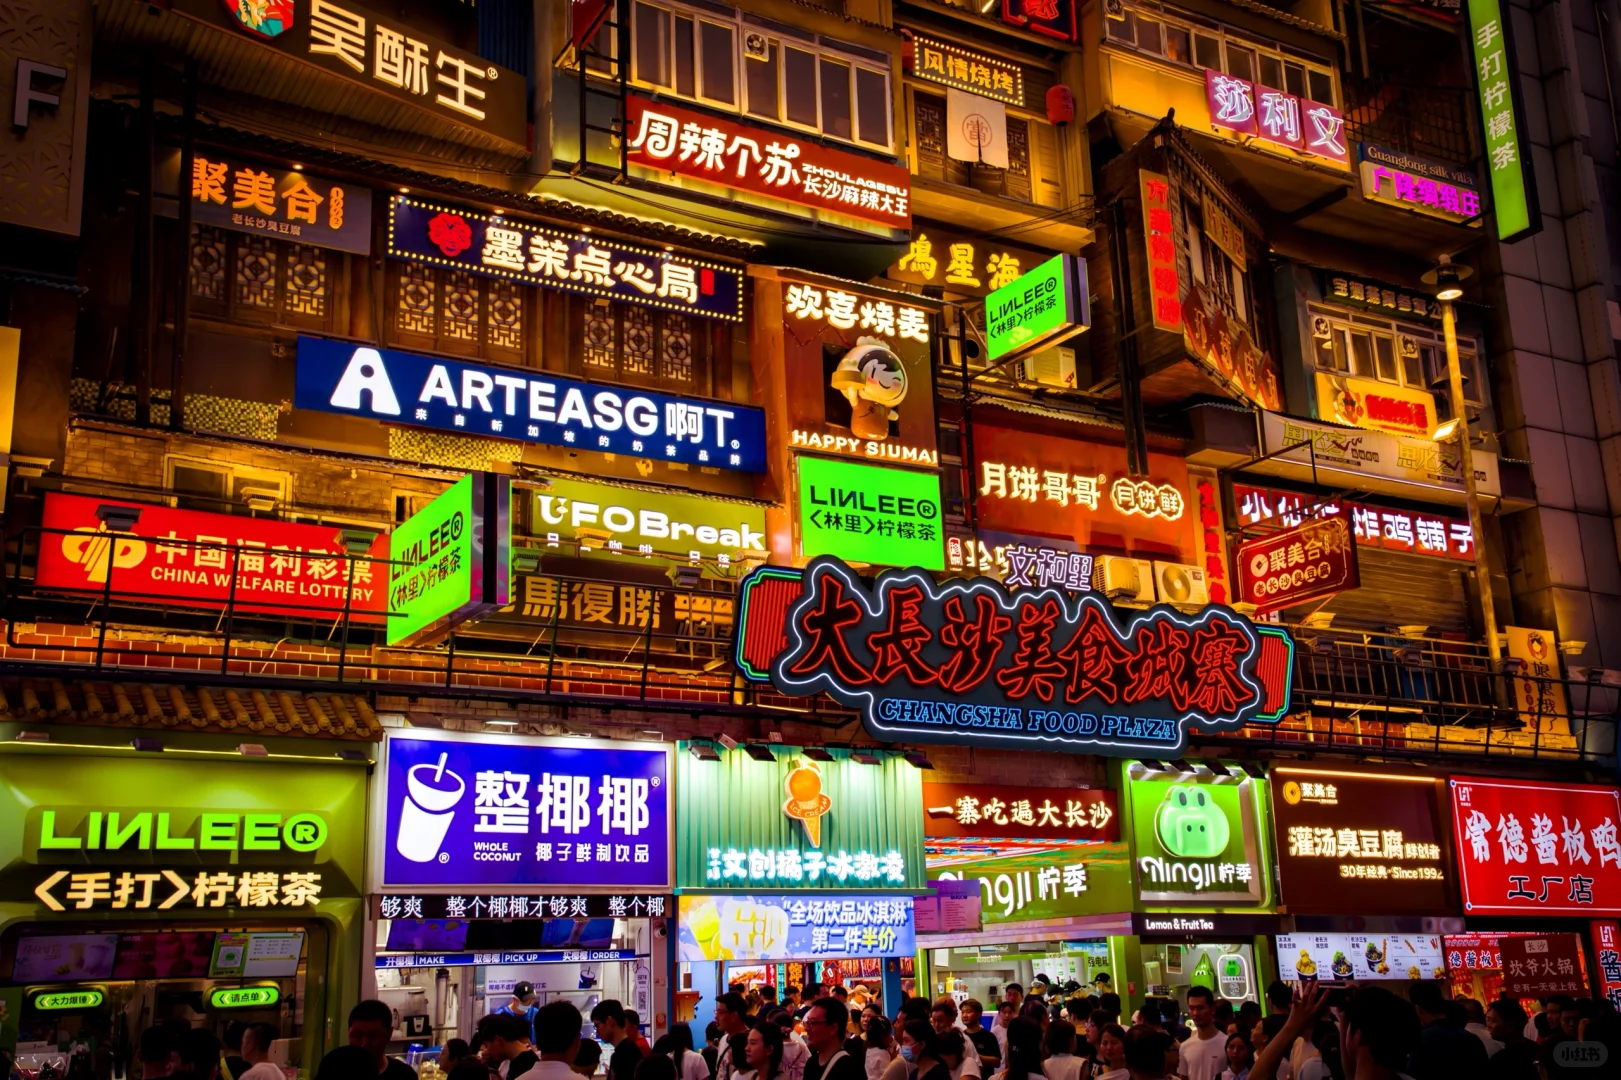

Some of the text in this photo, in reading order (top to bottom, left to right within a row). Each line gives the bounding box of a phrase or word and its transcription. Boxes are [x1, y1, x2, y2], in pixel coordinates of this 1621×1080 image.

[924, 48, 1013, 95] 风情烧烤
[1477, 20, 1516, 171] 手打柠檬茶
[1212, 74, 1346, 155] 莎利文
[802, 163, 907, 196] ZHOULAGESU
[1368, 146, 1473, 185] Guanglong silk villa
[192, 158, 324, 224] 聚美合
[803, 174, 908, 217] 长沙麻辣大王
[231, 213, 301, 236] 老长沙臭豆腐
[482, 226, 698, 303] 墨茉点心局
[785, 285, 930, 343] 欢喜烧麦
[420, 364, 659, 436] ARTEASG
[791, 430, 939, 464] HAPPY SIUMAI
[155, 531, 374, 584] 中国福利彩票
[1006, 546, 1092, 591] 文和里
[1268, 537, 1323, 572] 聚美合
[151, 567, 374, 602] CHINA WELFARE LOTTERY
[1253, 561, 1331, 597] 老长沙臭豆腐
[790, 573, 1253, 714] 大長沙美食城寨
[878, 699, 1178, 740] CHANGSHA FOOD PLAZA
[804, 797, 828, 818] CREAM
[1300, 782, 1338, 799] 聚美合
[928, 795, 1112, 829] 一寨吃遍大长沙
[473, 842, 509, 851] WHOLE
[536, 842, 649, 863] 椰子鲜制饮品
[1287, 826, 1404, 860] 灌汤臭豆腐
[1465, 809, 1621, 869] 常德酱板鸭
[473, 852, 522, 862] COCONUT
[1219, 862, 1252, 884] 柠季
[1038, 863, 1087, 899] 柠季
[1507, 874, 1594, 903] 工厂店
[380, 895, 665, 918] 够爽 整个椰椰才够爽 整个椰
[811, 928, 897, 953] 第二件半价
[1145, 918, 1214, 930] Lemon & Fruit Tea
[418, 956, 445, 965] MAKE
[504, 954, 524, 963] PICK
[526, 953, 538, 962] UP
[592, 951, 620, 960] ORDER
[1527, 942, 1547, 951] 长沙
[1509, 958, 1574, 977] 坎爷火锅
[231, 991, 261, 1003] 请点单
[1513, 982, 1578, 993] 总有一天爱上我
